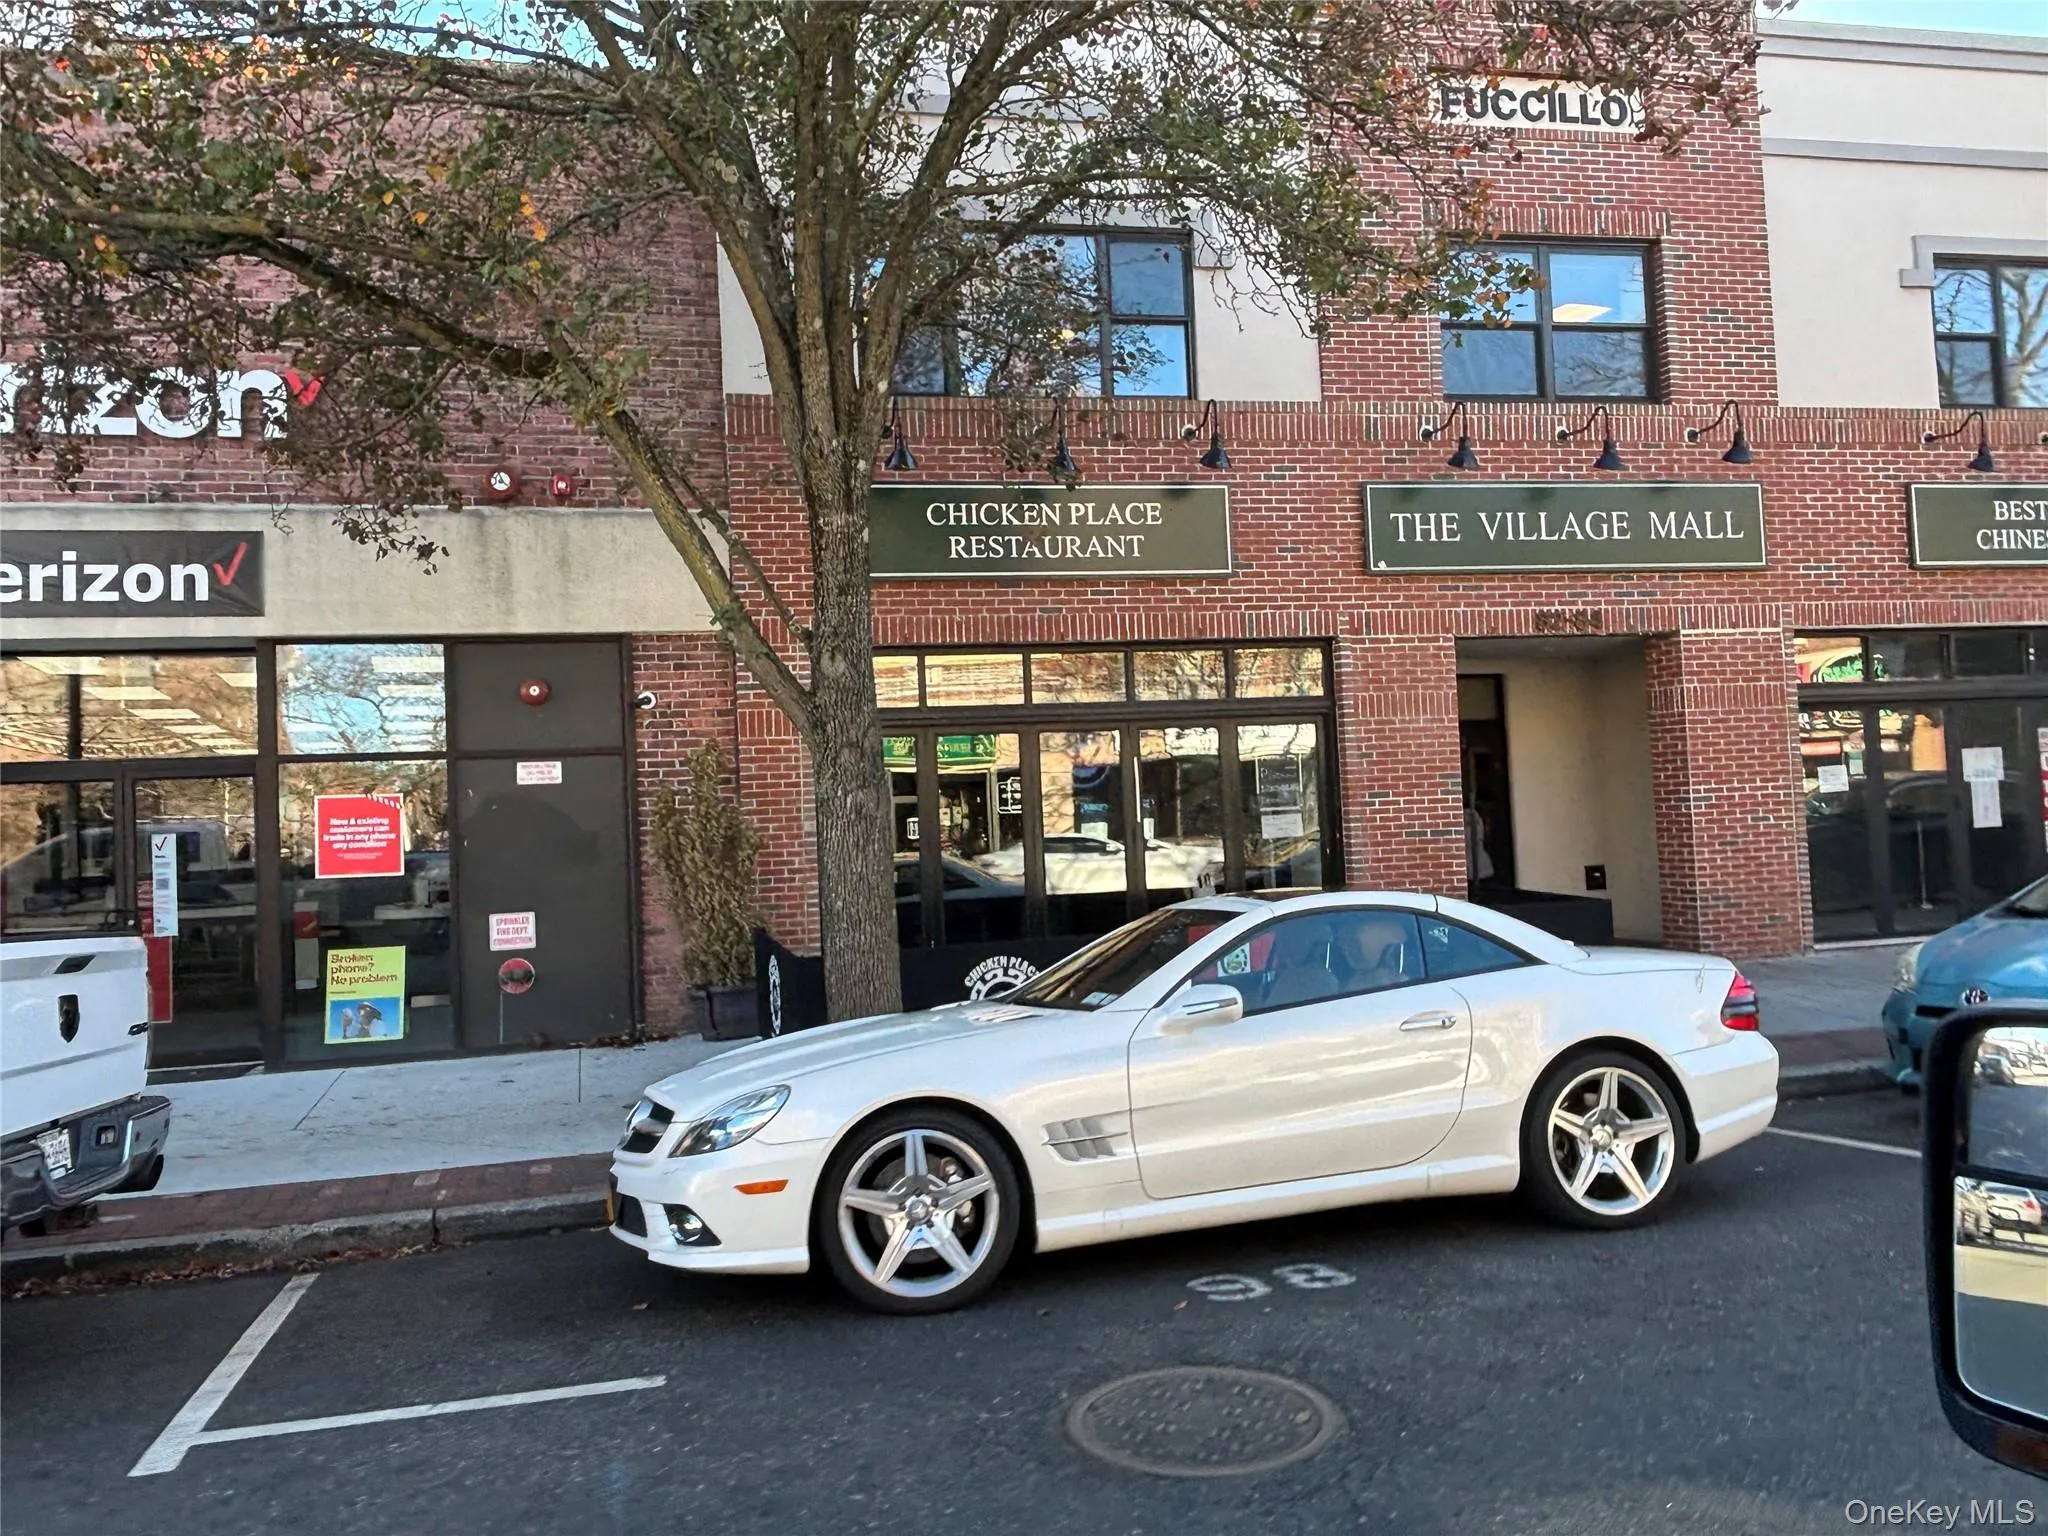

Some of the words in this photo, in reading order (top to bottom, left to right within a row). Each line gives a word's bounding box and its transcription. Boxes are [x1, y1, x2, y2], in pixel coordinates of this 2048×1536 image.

[1441, 86, 1628, 127] FUCCILLO
[926, 502, 1061, 526] CHICKEN
[1068, 502, 1163, 526] PLACE
[1993, 500, 2048, 521] BEST
[1390, 512, 1461, 543] THE
[1477, 510, 1632, 542] VILLAGE
[1649, 510, 1745, 540] MALL
[949, 535, 1145, 559] RESTAURANT
[1976, 528, 2048, 551] CHINE
[331, 954, 374, 964] Broken
[331, 963, 375, 975] phone?
[331, 975, 347, 986] No
[349, 973, 398, 986] problem
[964, 955, 1008, 987] CHICKEN
